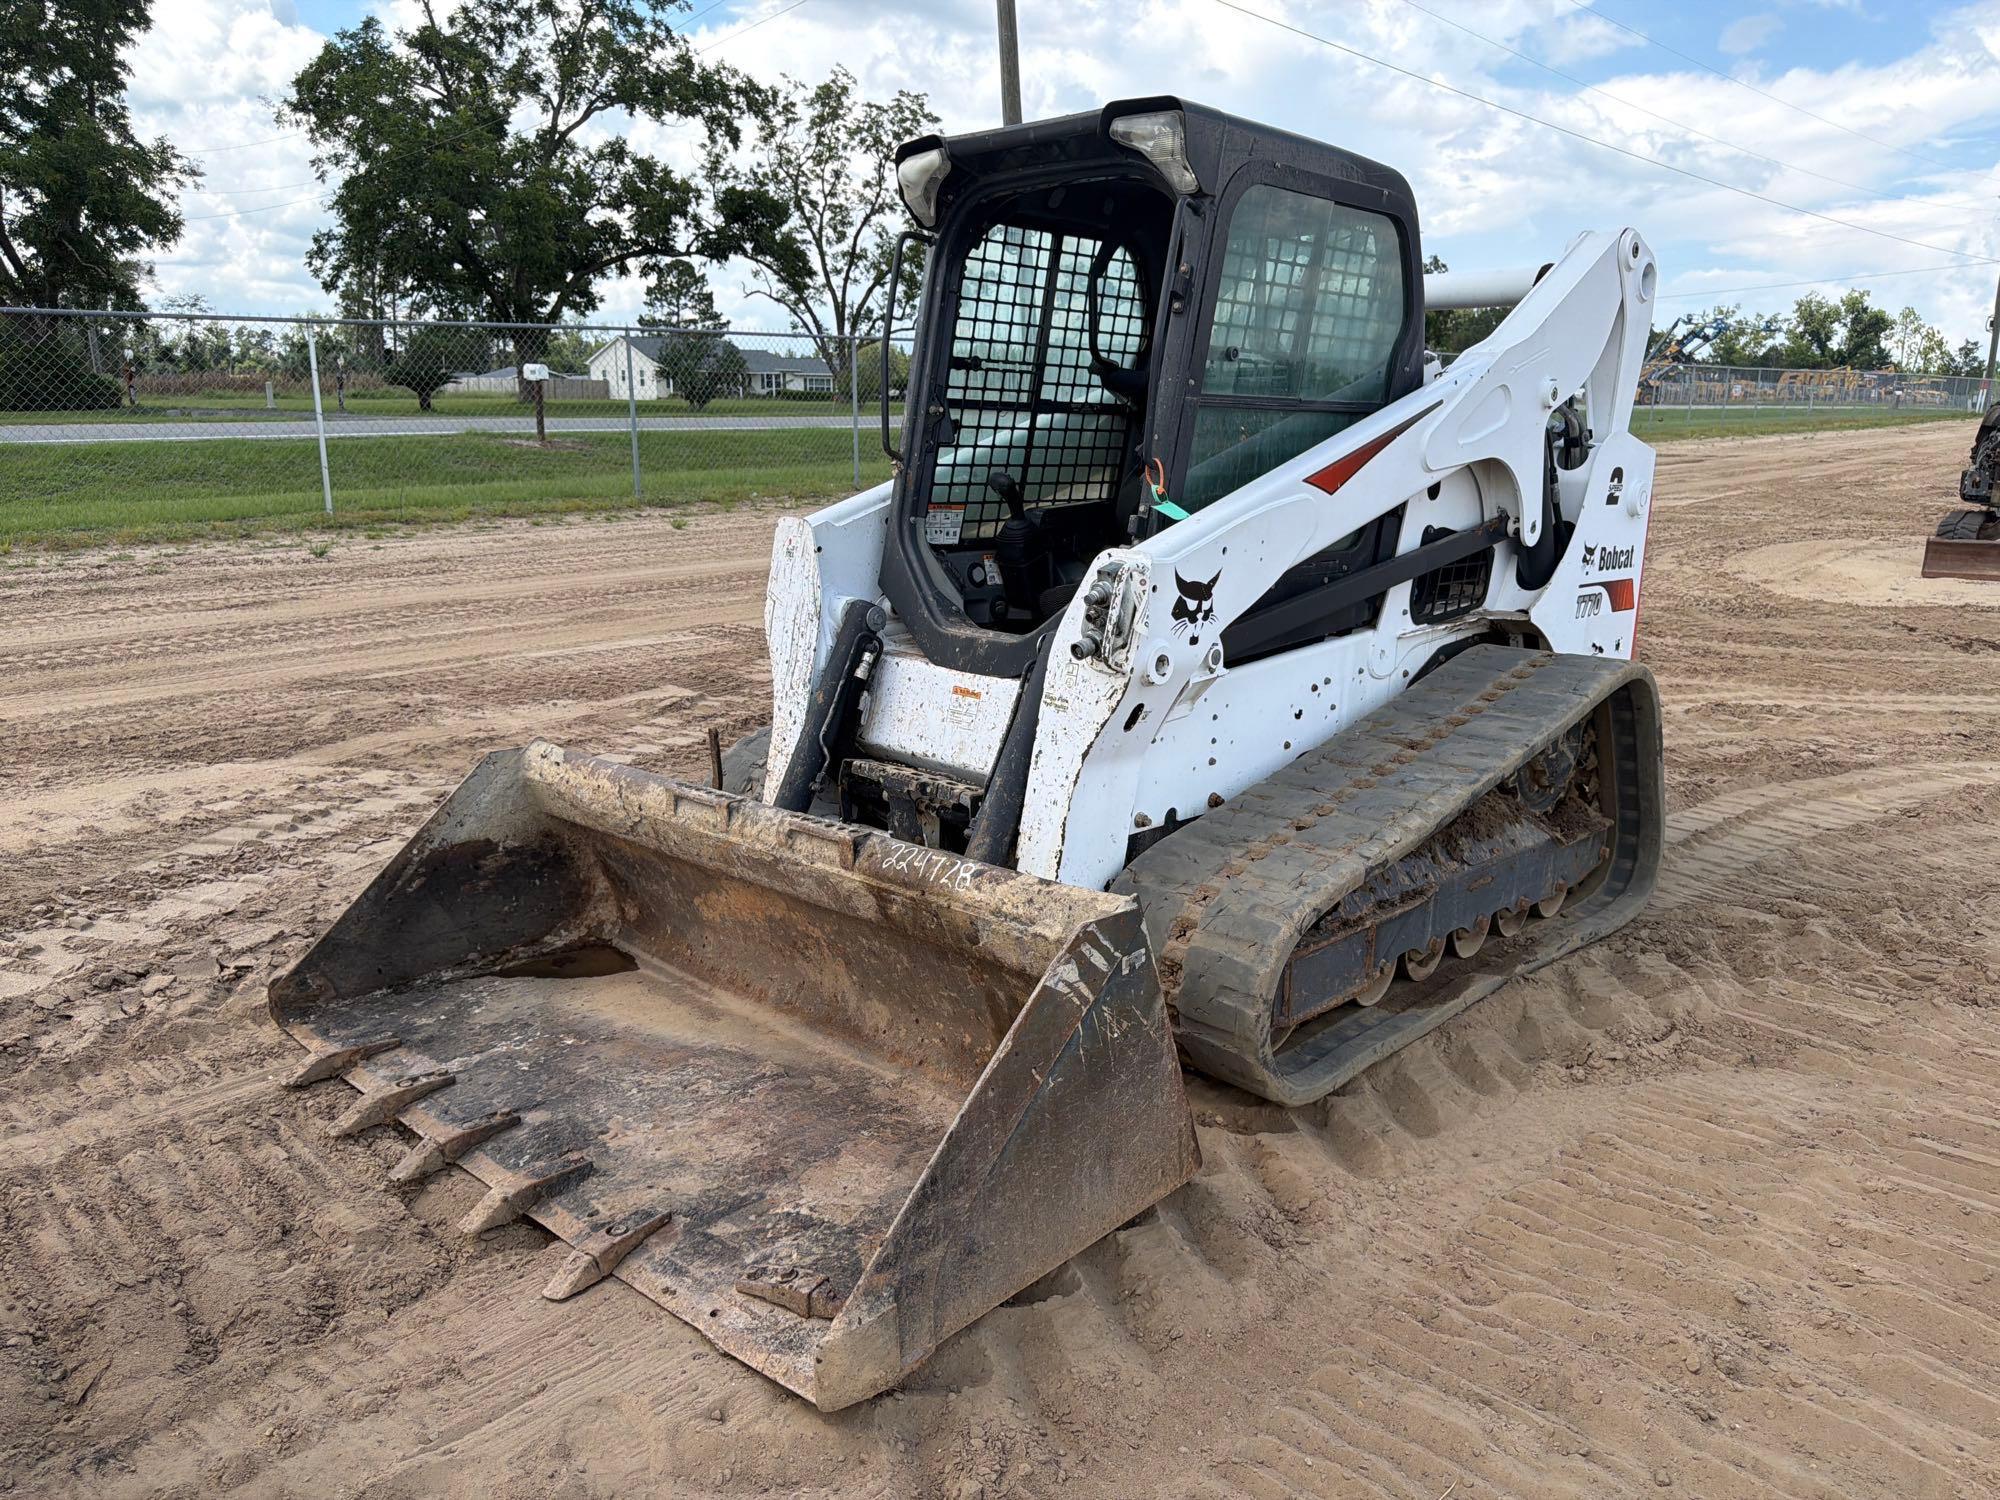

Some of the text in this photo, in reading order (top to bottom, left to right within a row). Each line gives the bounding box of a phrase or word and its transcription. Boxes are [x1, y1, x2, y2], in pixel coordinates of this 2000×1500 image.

[1605, 466, 1624, 505] 2
[1607, 484, 1624, 493] SPEED
[1598, 545, 1634, 572] Bobcat
[1575, 592, 1602, 619] T770
[882, 843, 976, 892] 224728
